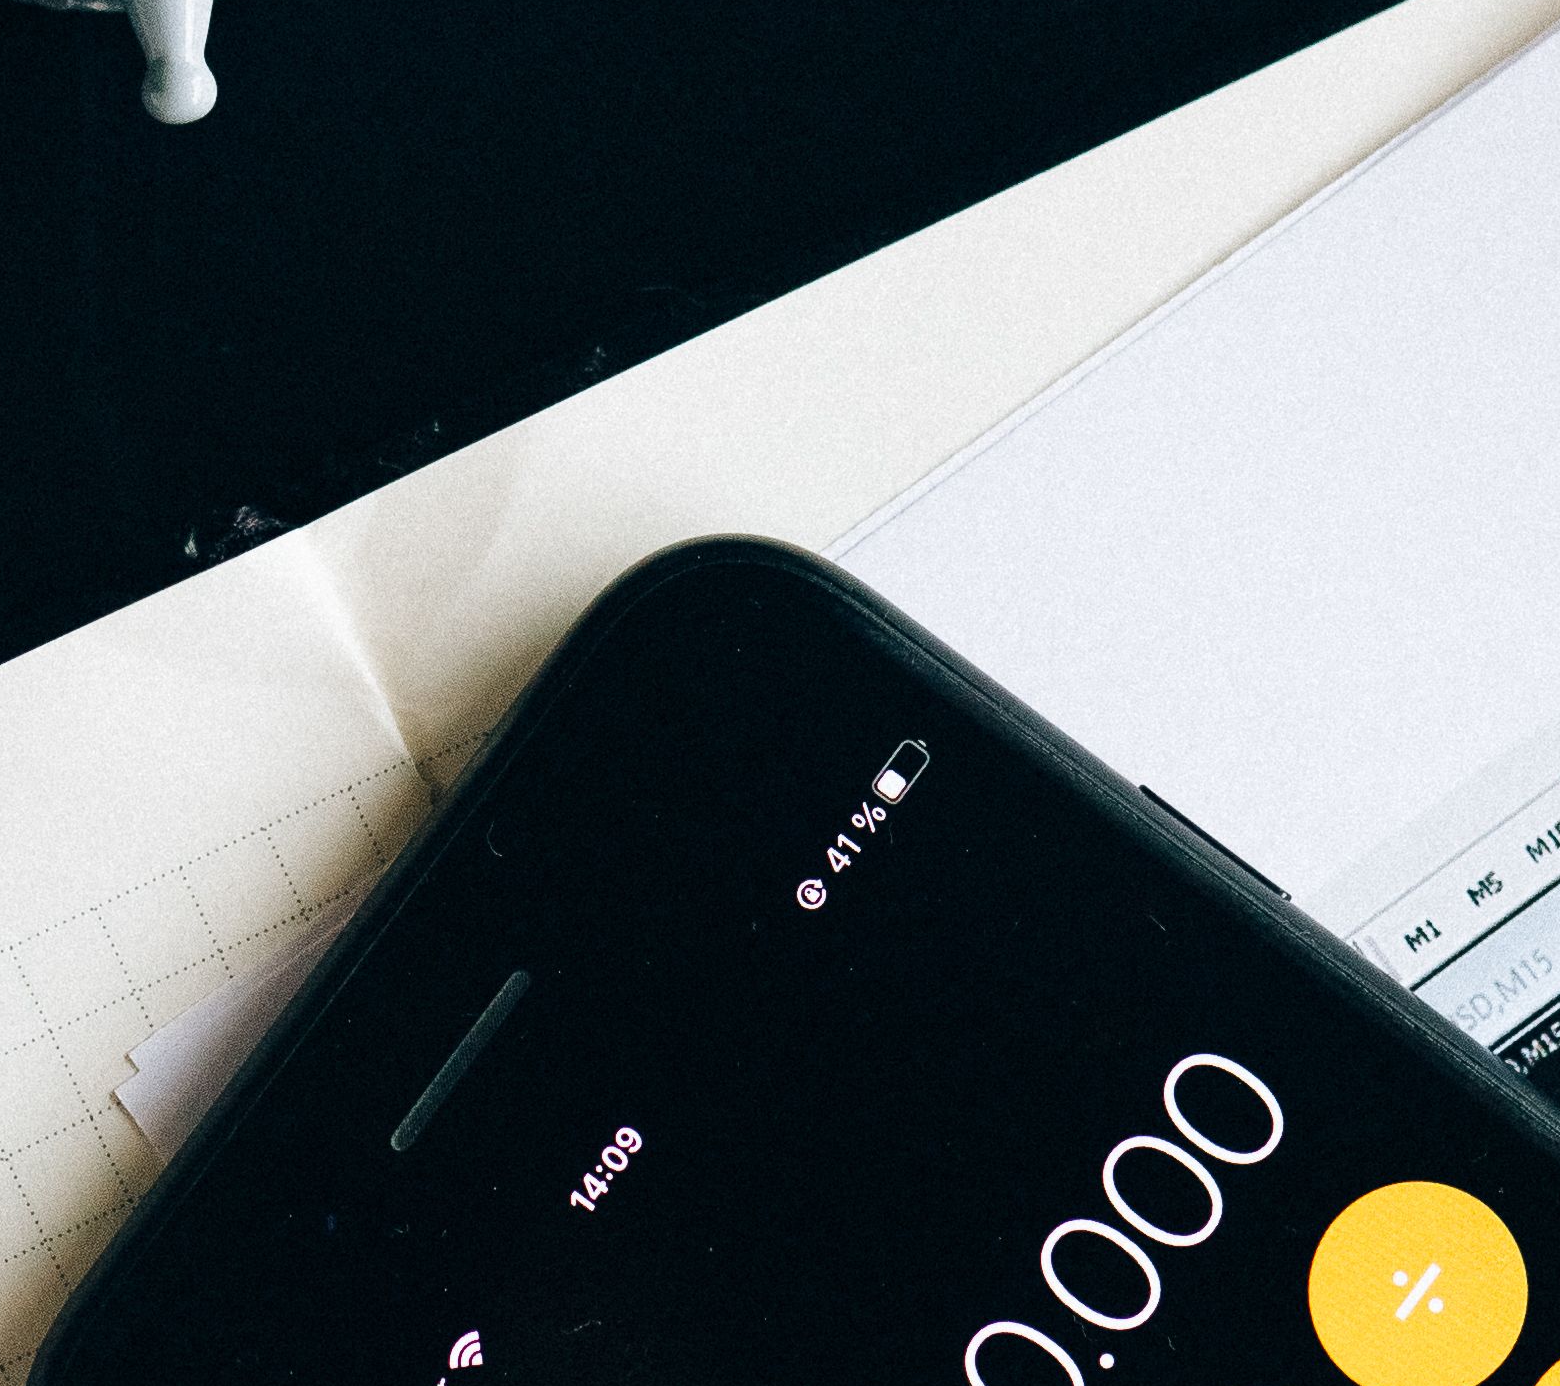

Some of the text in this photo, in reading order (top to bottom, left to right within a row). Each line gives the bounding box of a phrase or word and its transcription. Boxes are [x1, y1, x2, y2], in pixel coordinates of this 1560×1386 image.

[826, 801, 887, 873] 41 %
[1403, 919, 1442, 953] M1
[1466, 871, 1503, 907] M5
[1452, 948, 1553, 1031] SD,M15
[570, 1127, 643, 1212] 14:09
